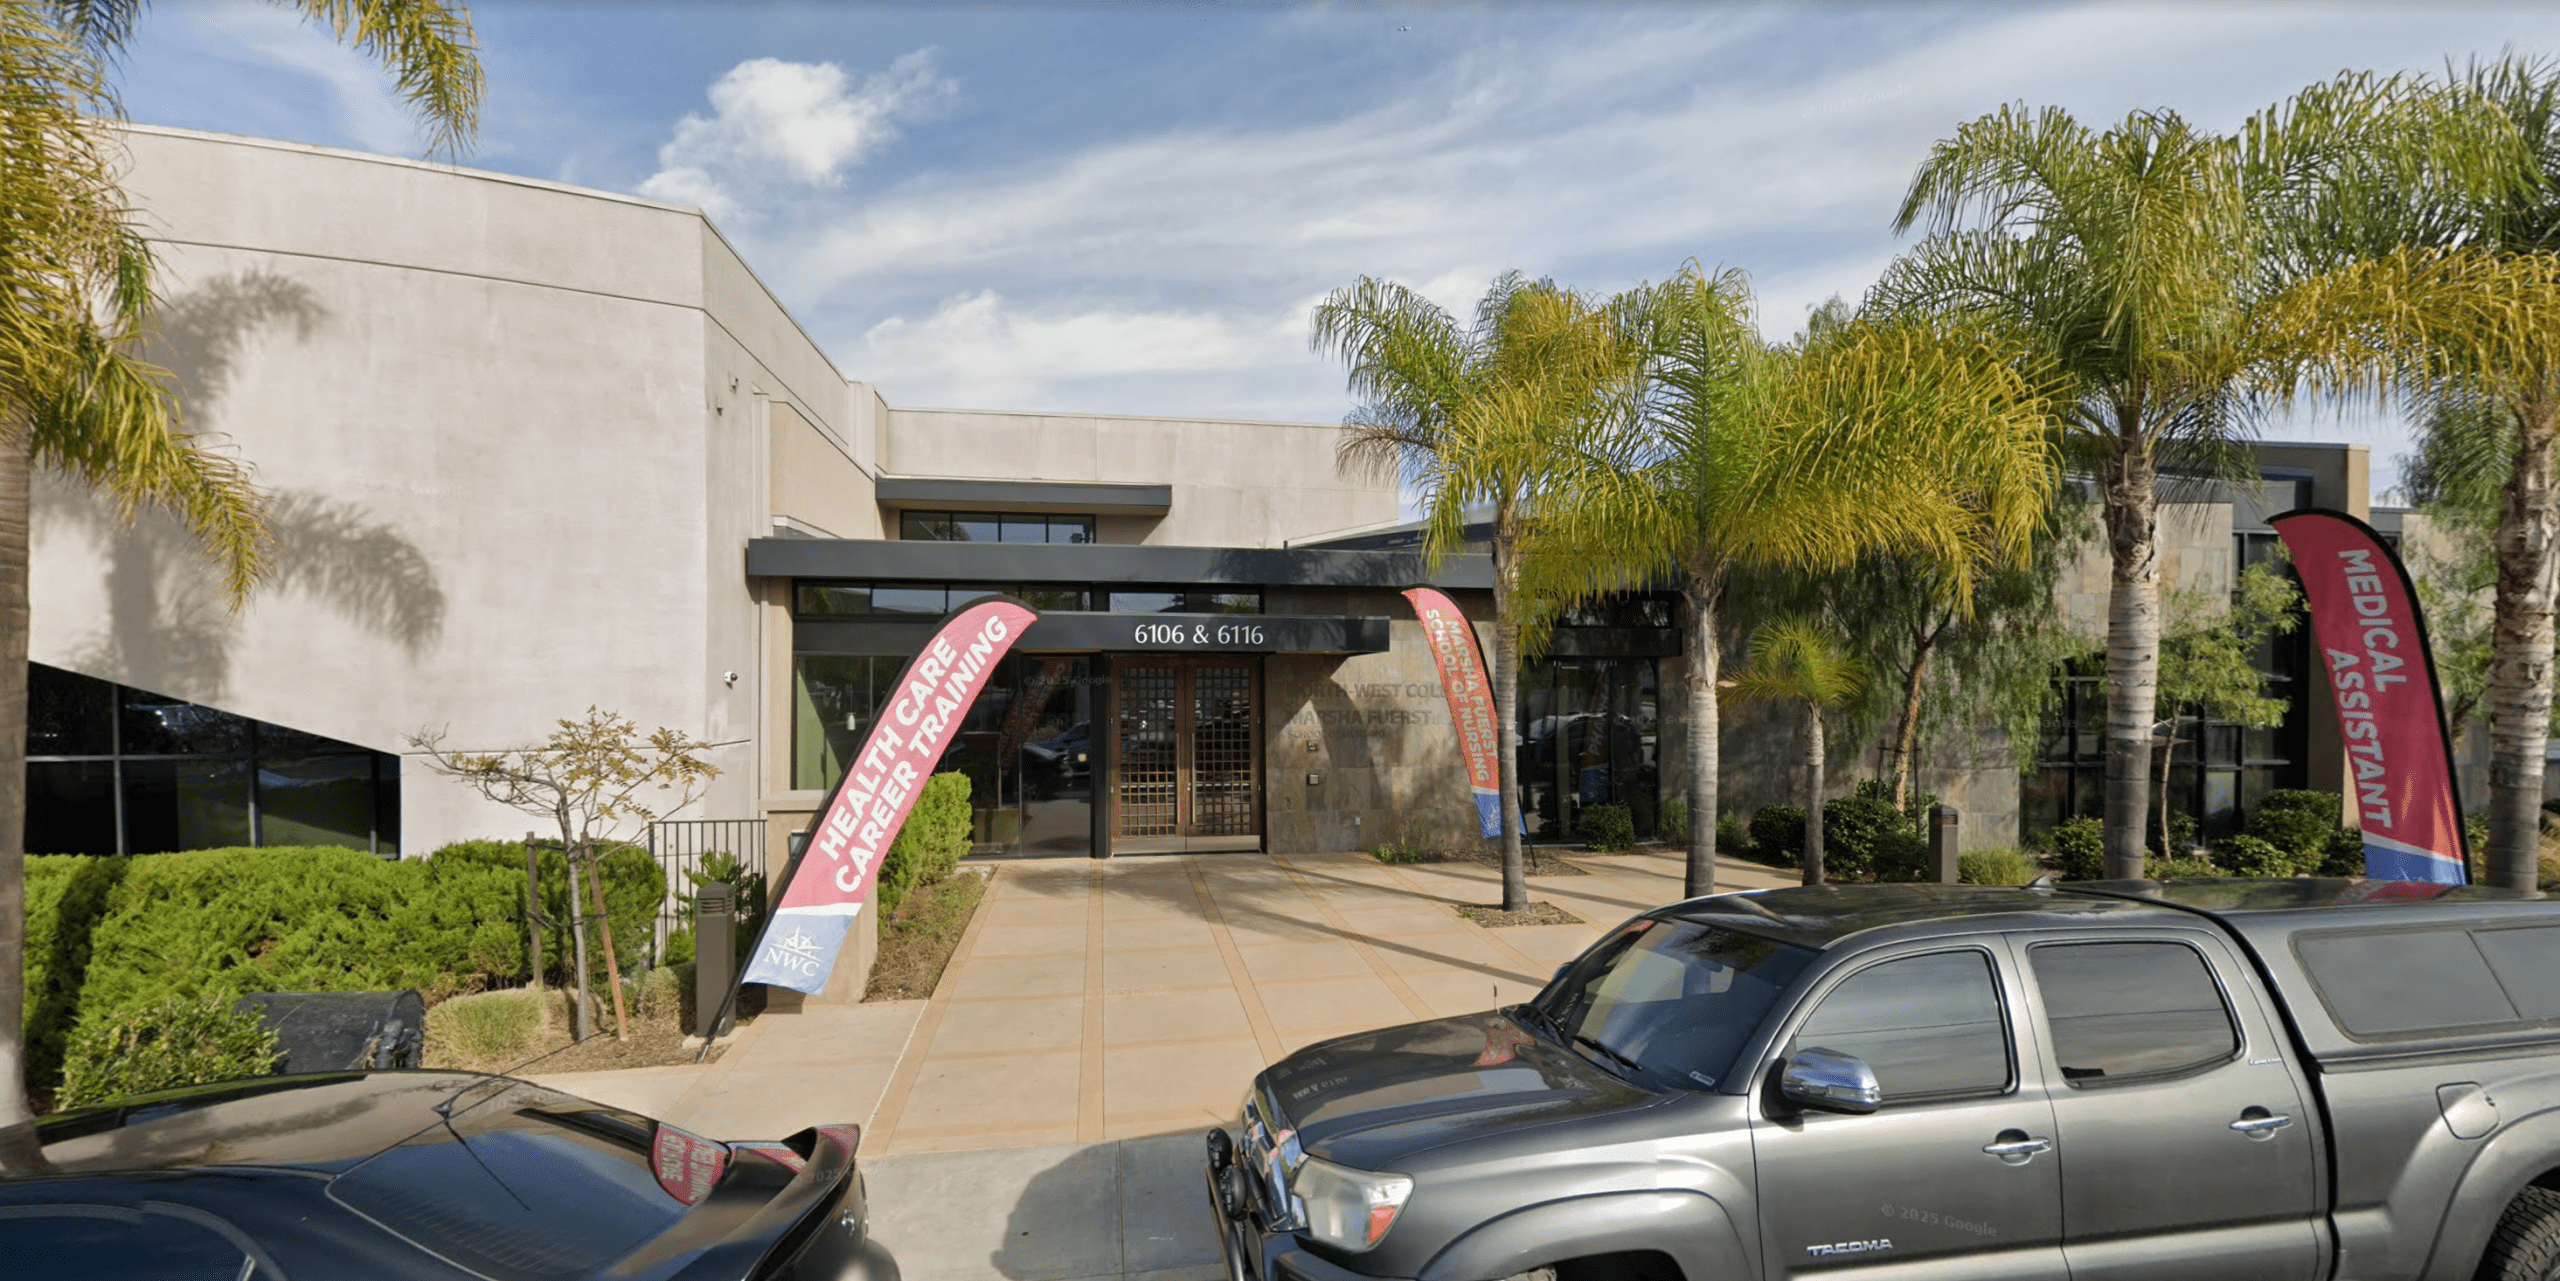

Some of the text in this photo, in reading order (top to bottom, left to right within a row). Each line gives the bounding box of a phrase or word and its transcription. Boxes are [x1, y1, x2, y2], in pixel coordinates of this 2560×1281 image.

[1134, 624, 1264, 645] 6106 & 6116
[1446, 620, 1498, 758] MARSHA FUERST
[2337, 548, 2407, 694] MEDICAL
[818, 636, 957, 861] HEALTH CARE
[835, 615, 1008, 893] CAREER TRAINING
[1367, 709, 1432, 725] FUERST
[1406, 683, 1447, 698] COLL
[1426, 609, 1490, 782] SCHOOL OF NURSING
[2327, 648, 2393, 829] ASSISTANT
[763, 947, 820, 977] NWC
[1806, 1238, 1894, 1257] TACOMA
